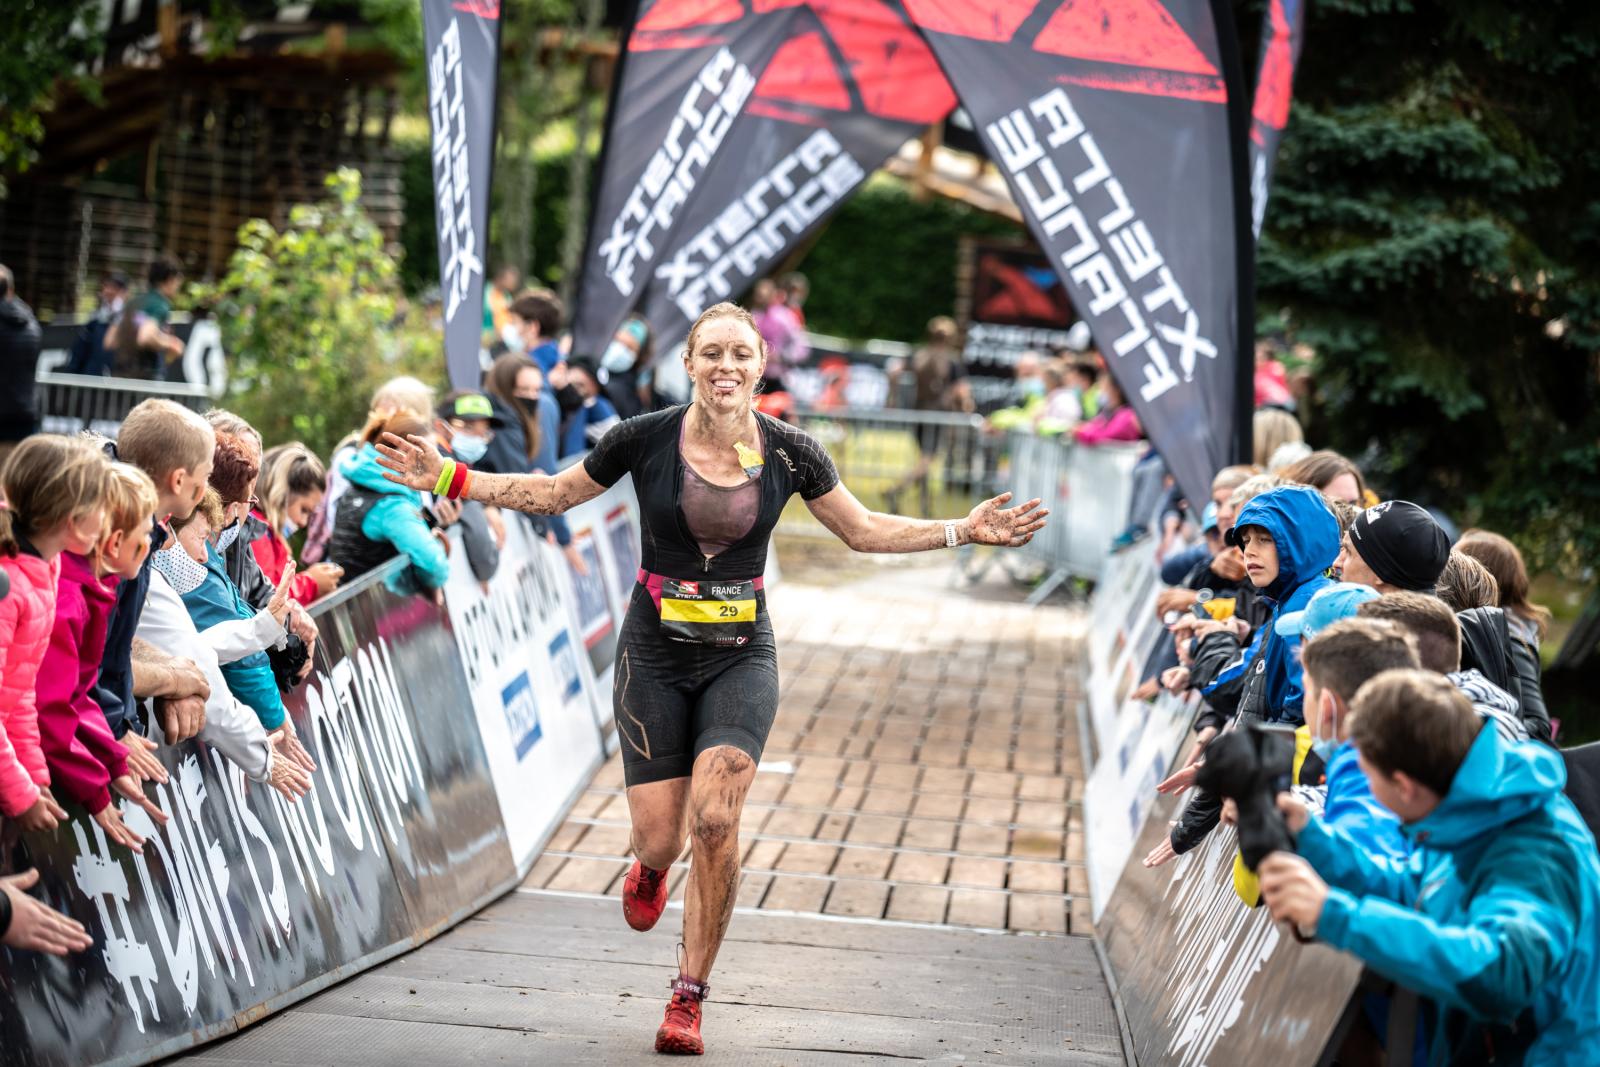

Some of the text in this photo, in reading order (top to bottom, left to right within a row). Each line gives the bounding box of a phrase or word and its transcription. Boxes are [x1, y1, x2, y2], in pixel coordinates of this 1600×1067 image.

[599, 47, 735, 276] XTERRA
[612, 64, 755, 296] FRANCE
[656, 128, 842, 298] XTERRA
[677, 151, 865, 321] FRANCE
[711, 585, 742, 596] FRANCE
[719, 605, 738, 617] 29
[209, 747, 291, 949] IS
[306, 636, 425, 858] OPTION
